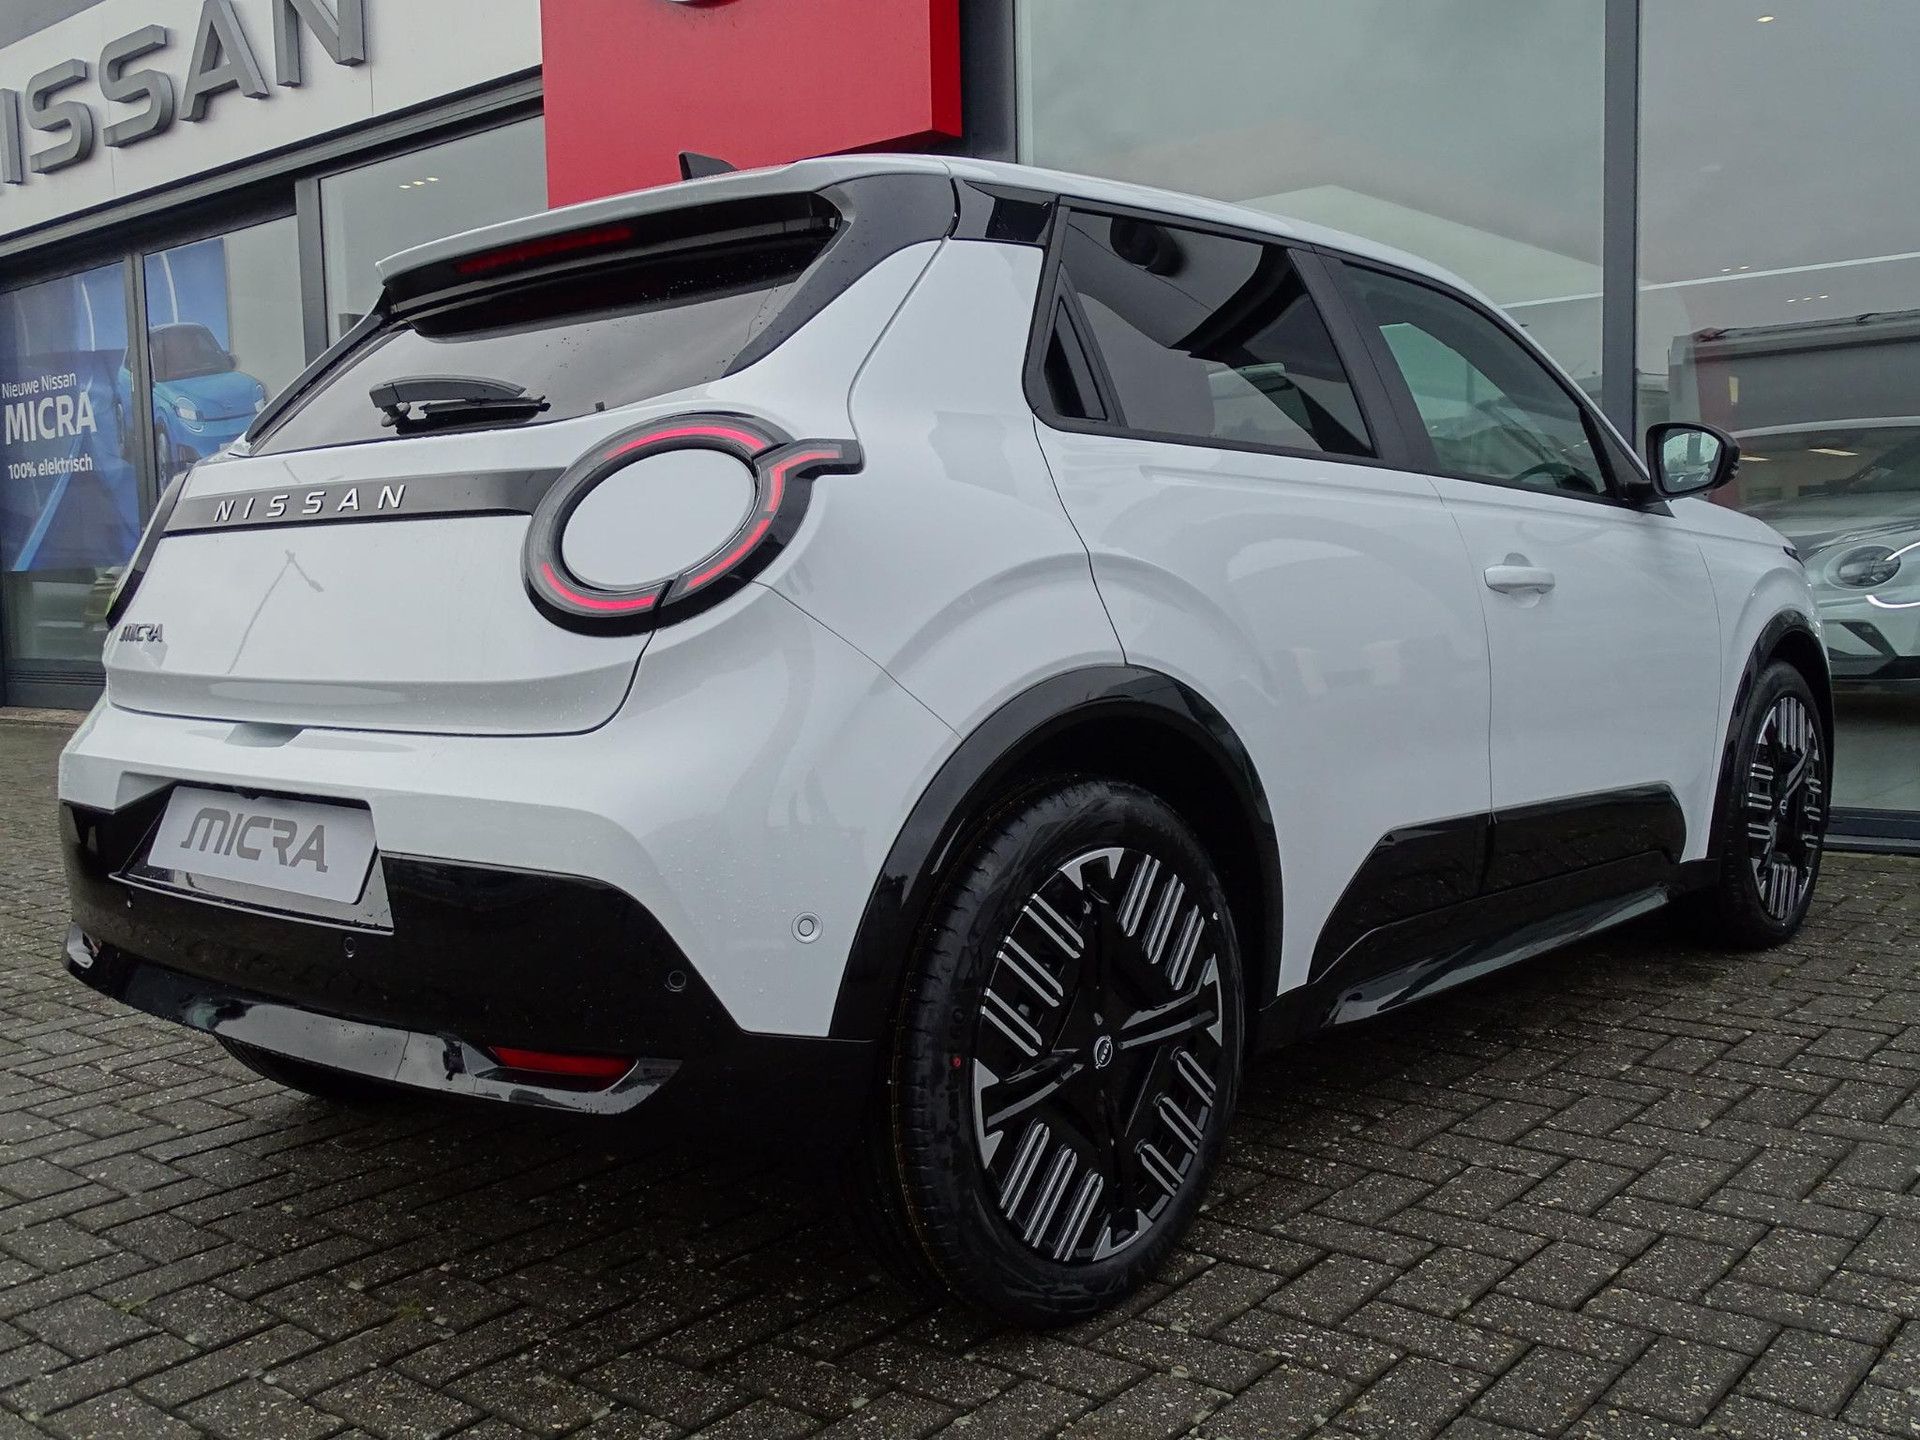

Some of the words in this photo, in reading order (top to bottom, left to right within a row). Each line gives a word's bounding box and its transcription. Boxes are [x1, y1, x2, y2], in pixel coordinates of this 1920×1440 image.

[0, 0, 367, 194] ISSAN
[2, 379, 39, 399] Nieuwe
[41, 372, 77, 391] Nissan
[5, 391, 98, 445] MICRA
[8, 461, 37, 480] 100%
[38, 453, 93, 476] elektrisch
[214, 485, 405, 522] NISSAN
[119, 623, 163, 642] MICRA
[180, 807, 328, 873] MICRA
